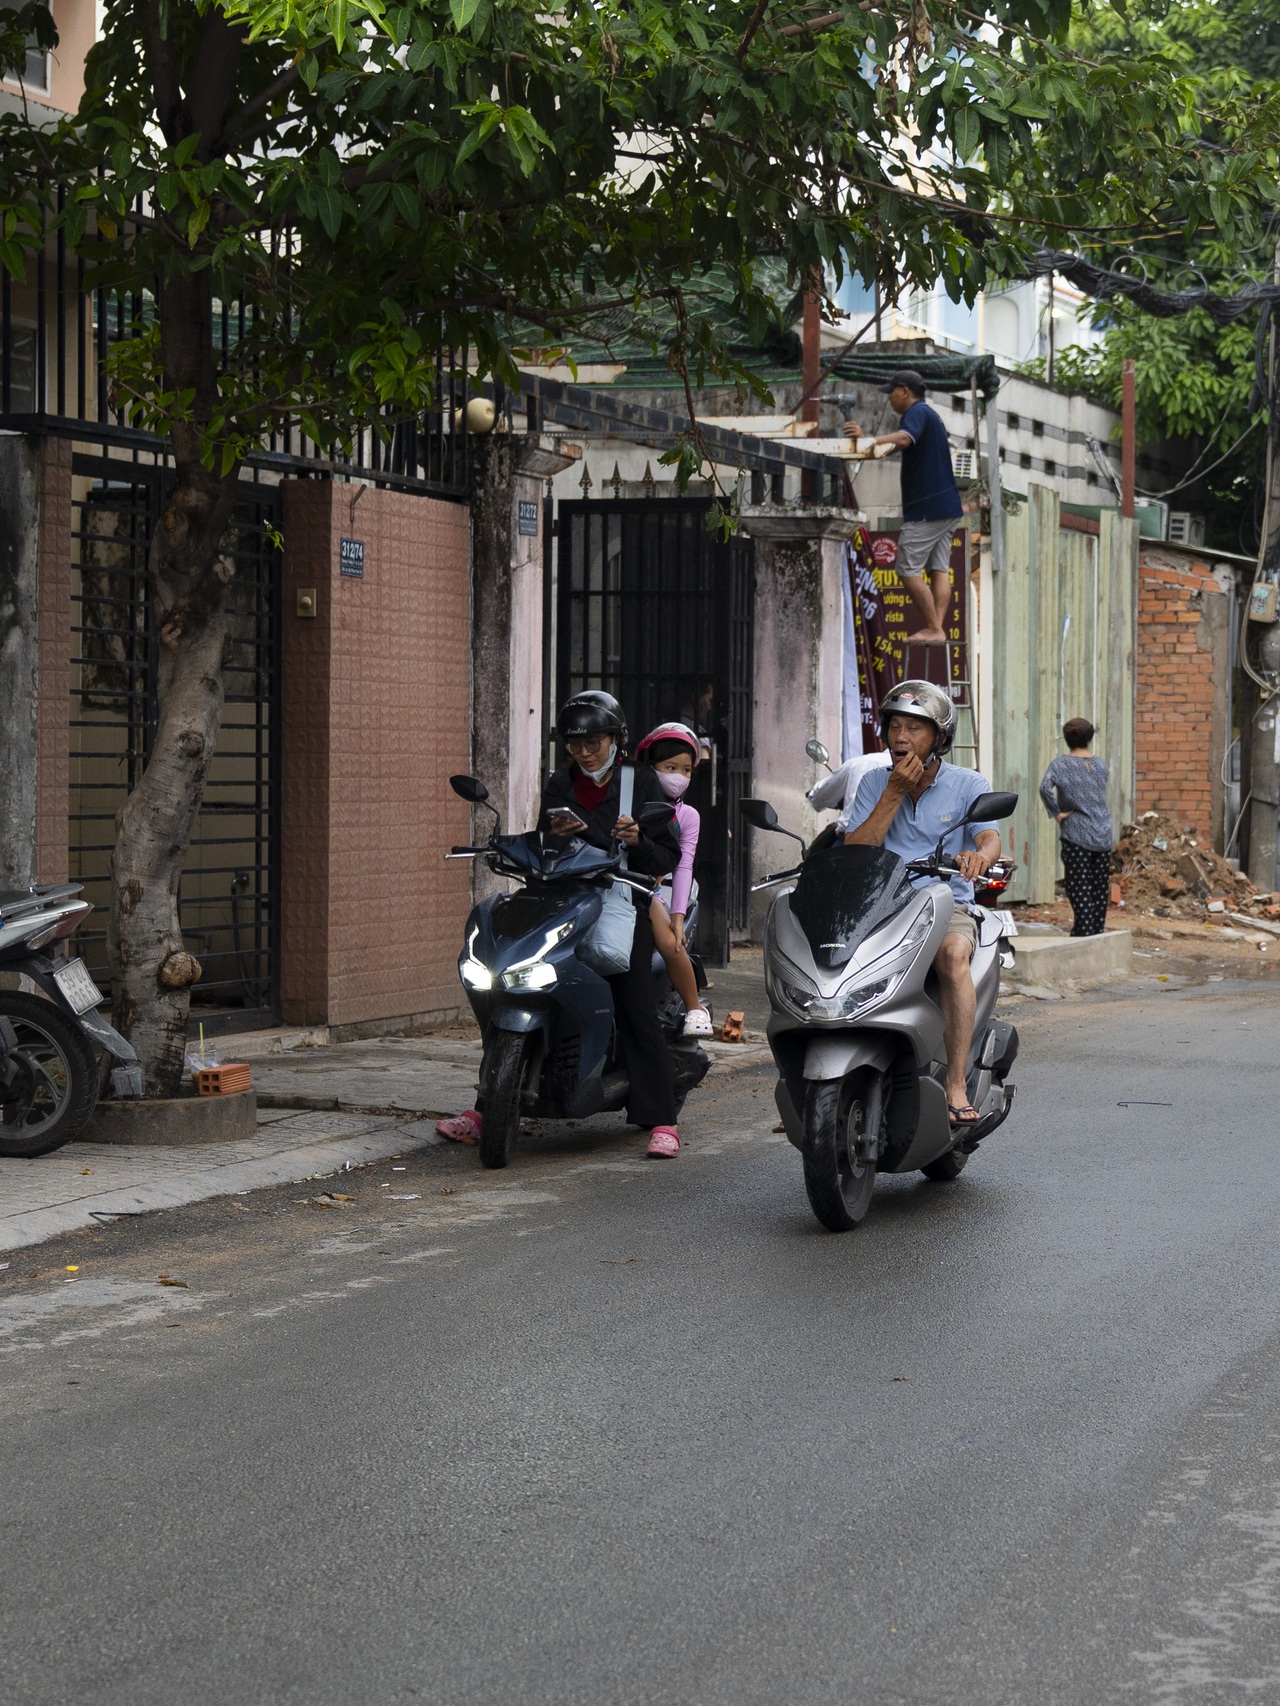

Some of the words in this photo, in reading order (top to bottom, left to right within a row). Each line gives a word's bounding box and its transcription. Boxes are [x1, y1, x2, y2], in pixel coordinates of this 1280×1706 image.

[953, 591, 959, 603] 1
[953, 610, 960, 621] 5
[949, 628, 960, 639] 10
[953, 646, 960, 658] 2
[953, 664, 960, 677] 5
